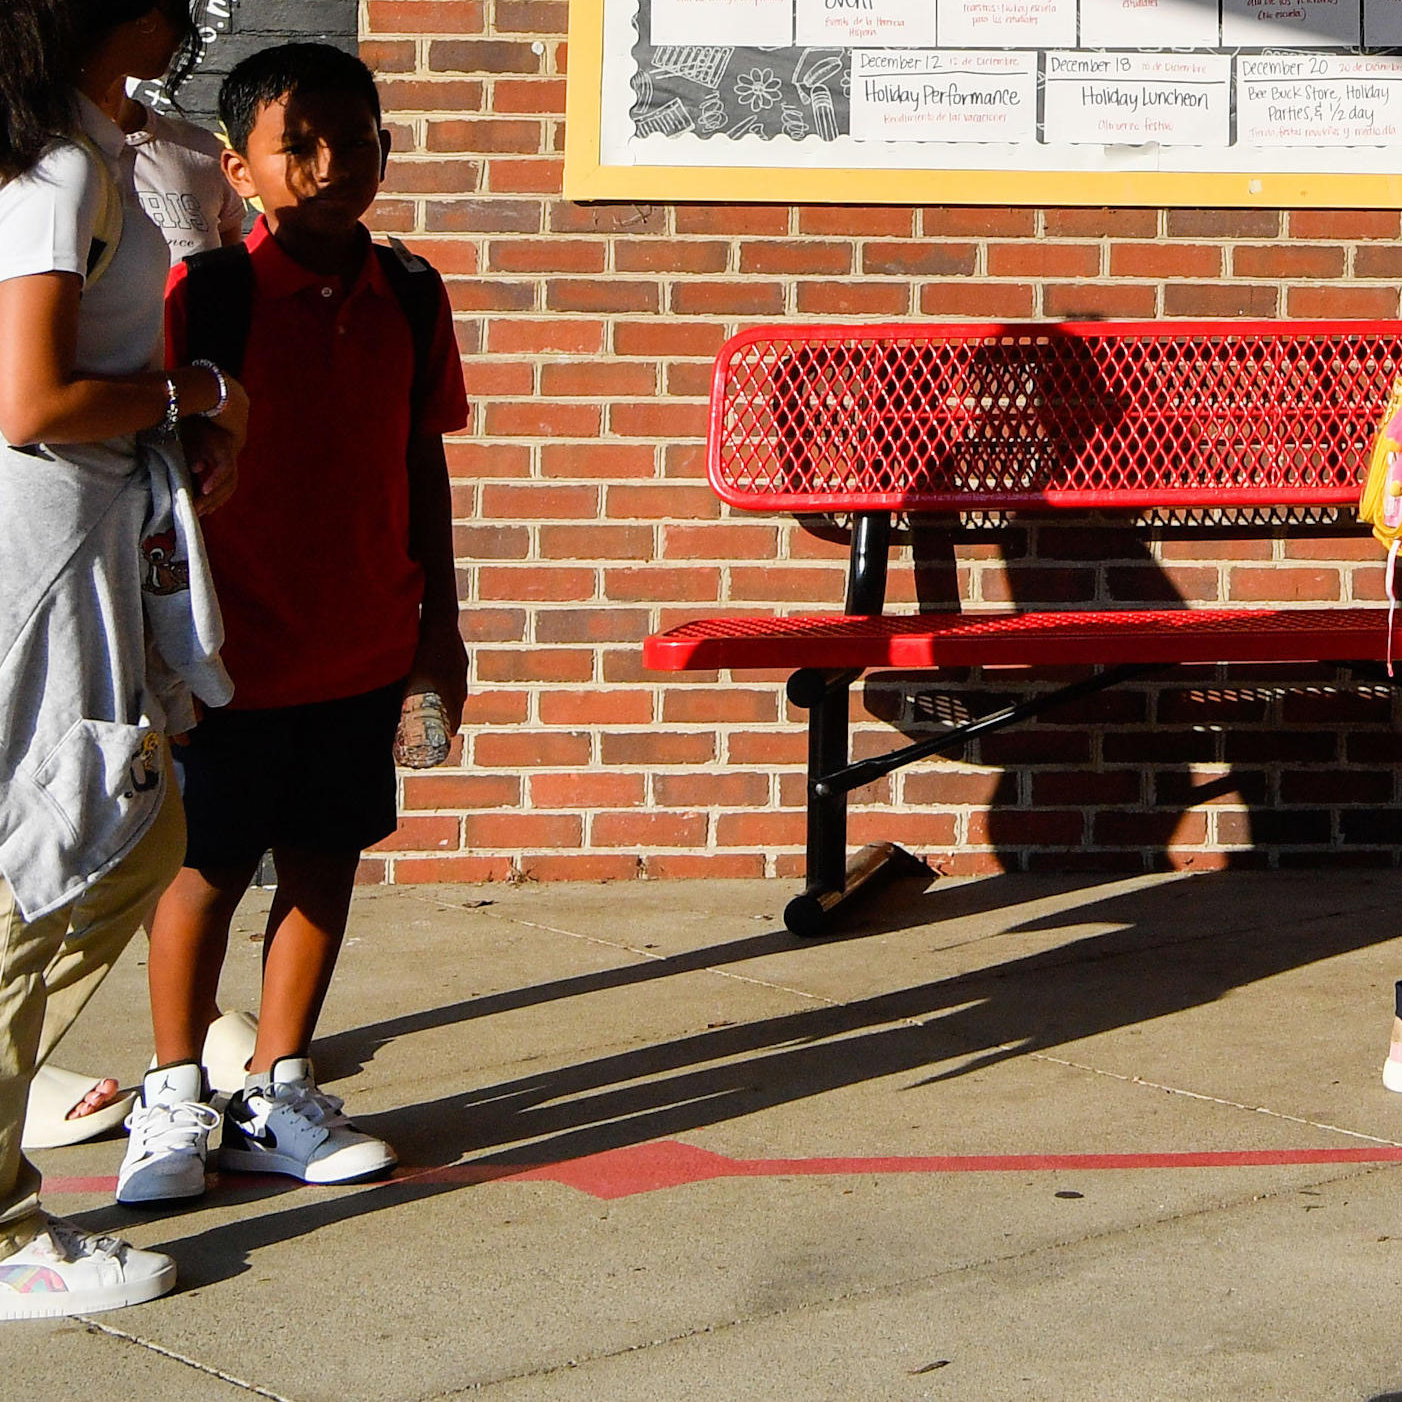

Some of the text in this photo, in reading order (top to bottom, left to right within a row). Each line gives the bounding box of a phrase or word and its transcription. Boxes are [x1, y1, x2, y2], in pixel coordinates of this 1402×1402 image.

[861, 53, 943, 70] December 12
[1051, 57, 1131, 73] December 18
[1242, 57, 1329, 76] December 20
[864, 79, 1020, 112] Holiday Performance
[1081, 86, 1208, 113] Holiday Luncheon
[1248, 84, 1390, 106] Bee Buck Store, Holiday
